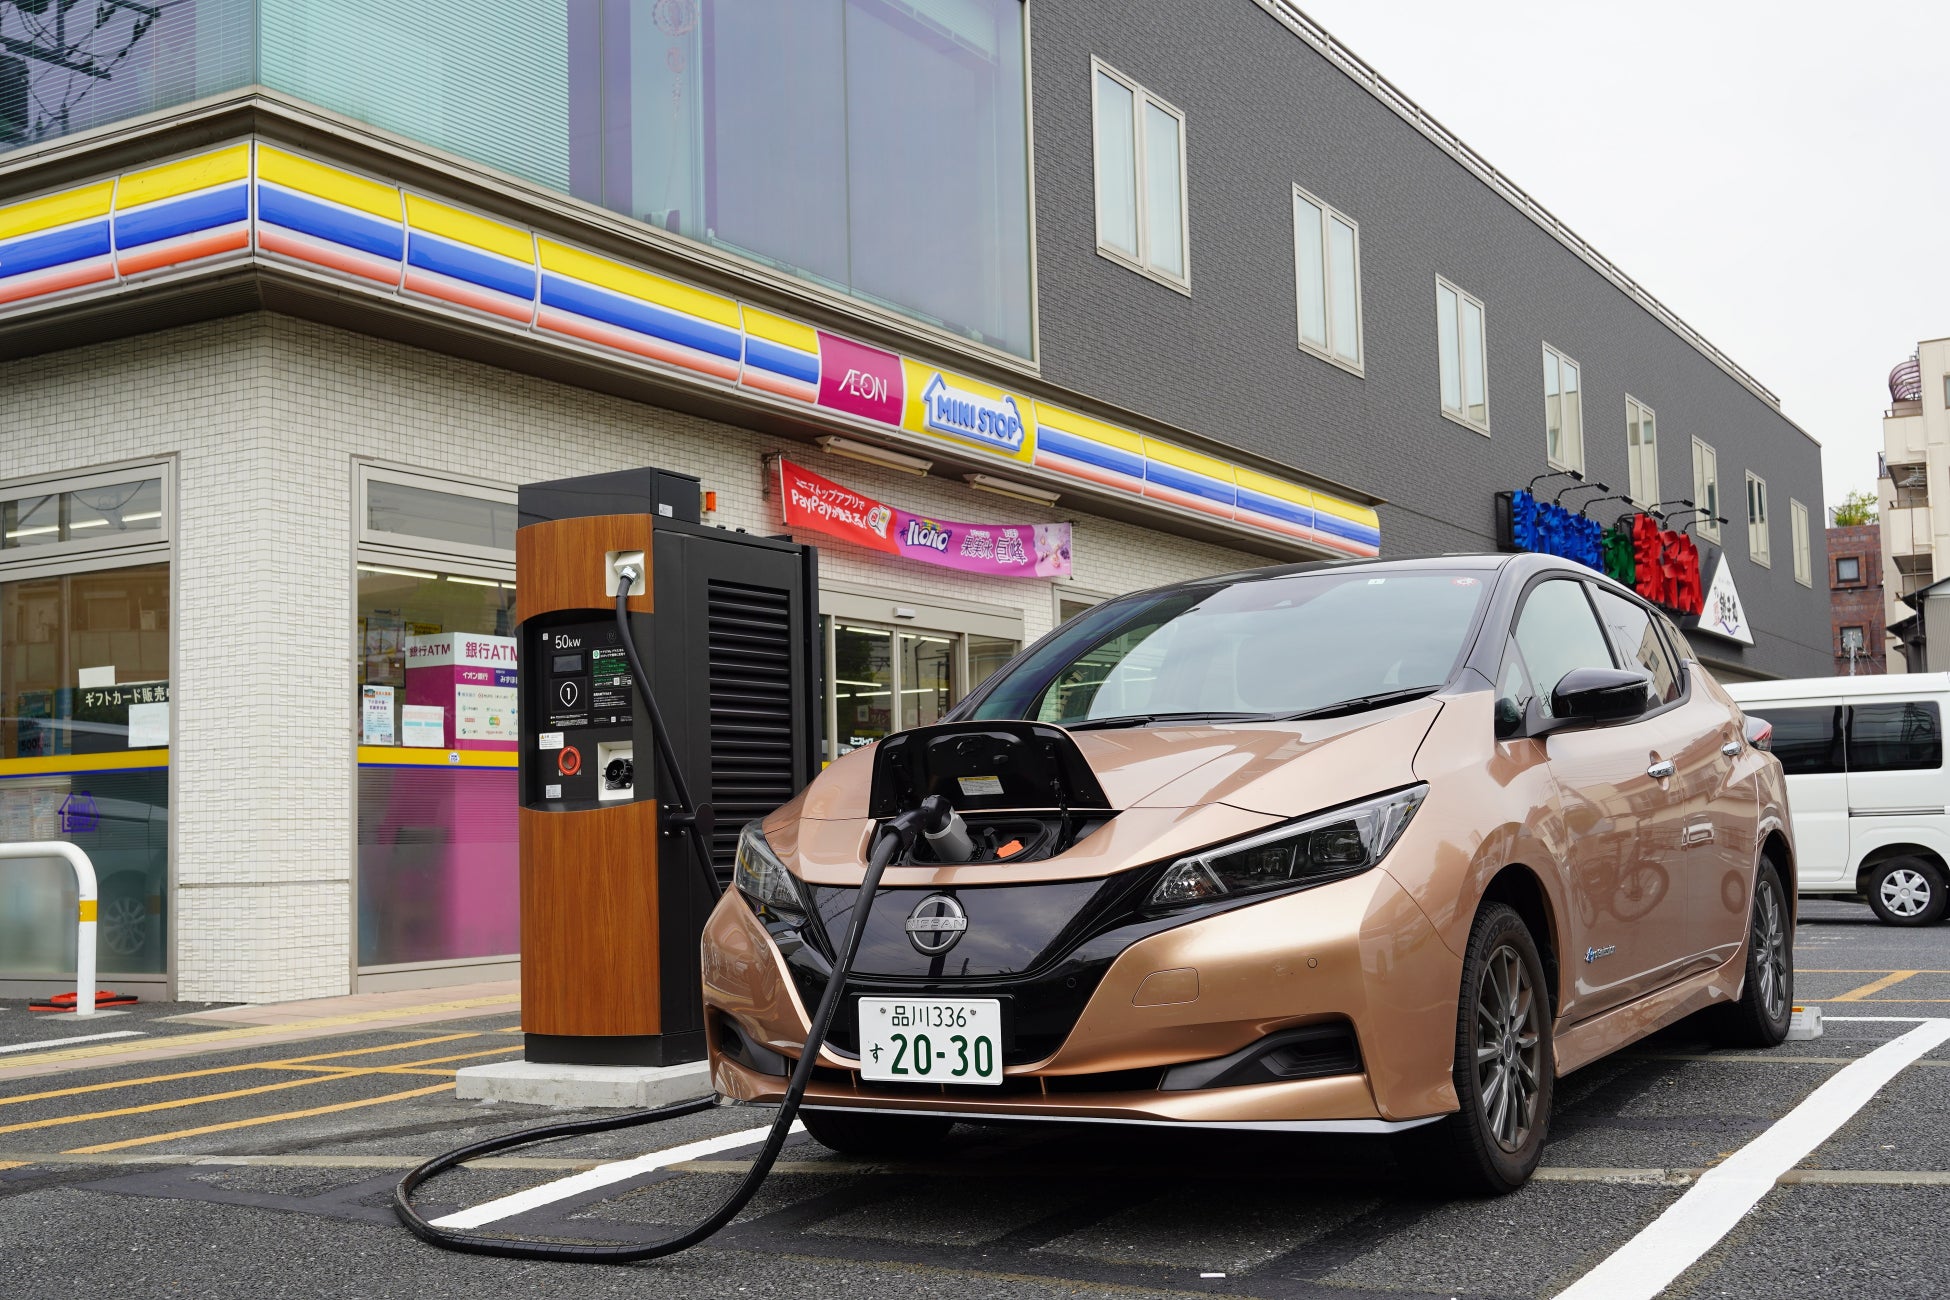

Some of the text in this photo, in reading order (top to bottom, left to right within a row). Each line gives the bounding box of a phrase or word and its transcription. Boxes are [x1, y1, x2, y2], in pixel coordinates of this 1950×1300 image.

[937, 394, 1019, 440] MINI STOP
[555, 634, 581, 649] 50kW
[409, 643, 450, 658] 銀行ATM
[462, 671, 488, 681] イオン銀行
[500, 675, 518, 685] みずほ
[566, 687, 571, 700] 1
[906, 918, 966, 930] NISSAN
[869, 1033, 993, 1077] す 20-30
